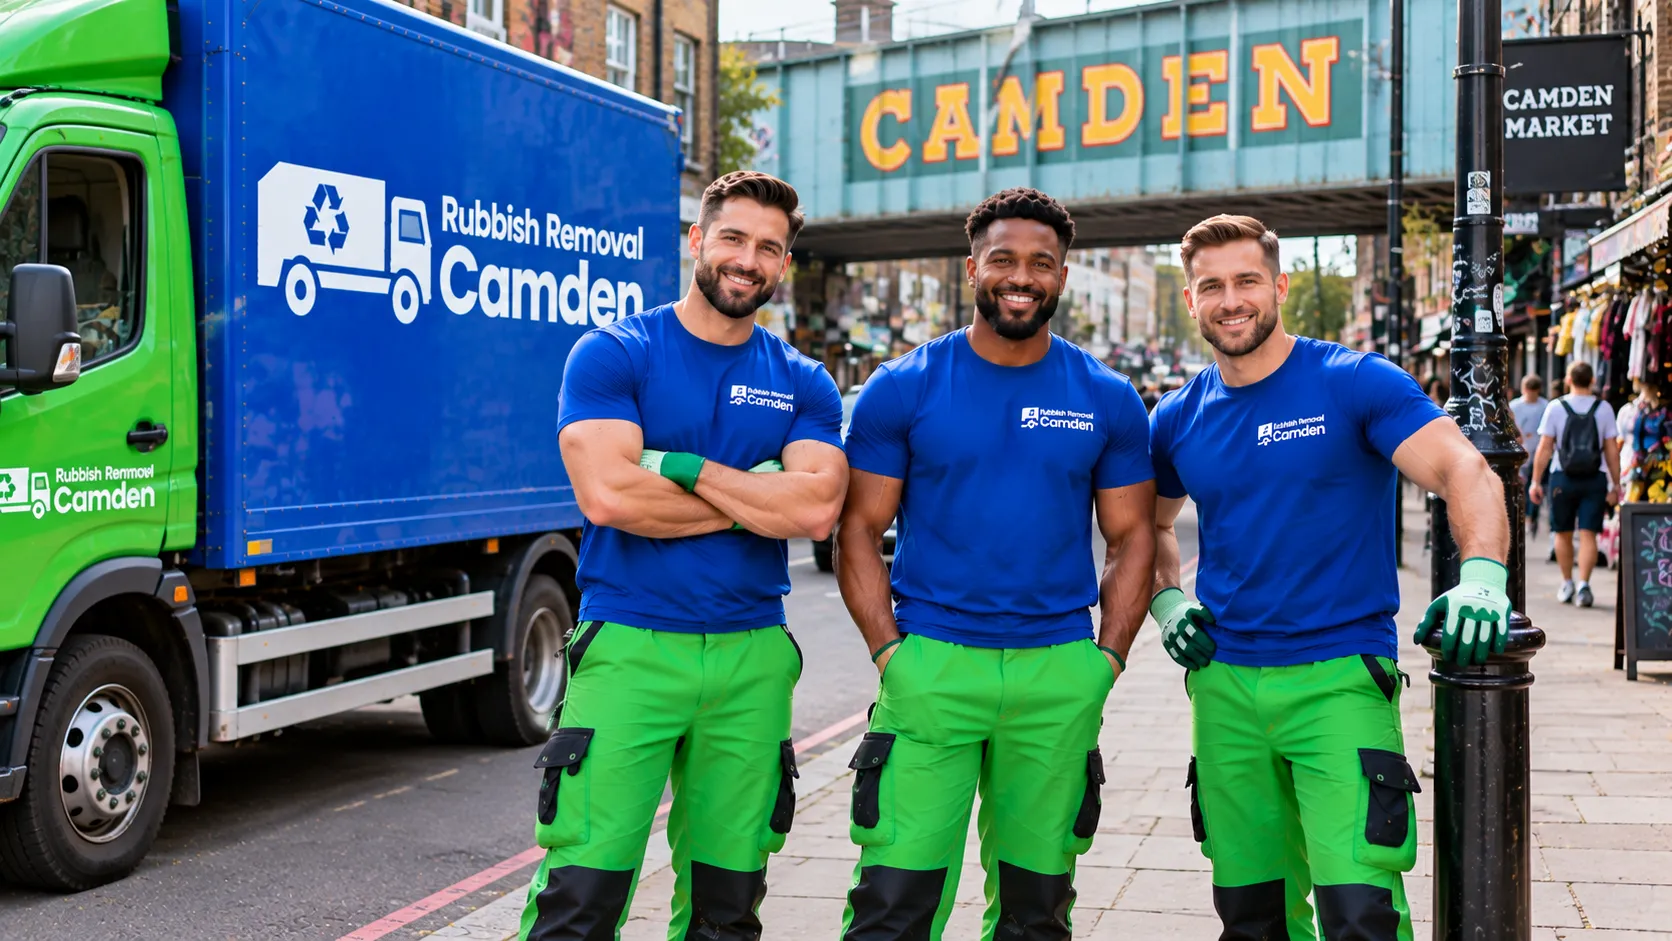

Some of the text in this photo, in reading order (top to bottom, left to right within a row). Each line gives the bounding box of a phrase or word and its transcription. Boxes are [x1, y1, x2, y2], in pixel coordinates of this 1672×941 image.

[860, 36, 1340, 172] CAMDEN
[1502, 84, 1614, 111] CAMDEN
[1505, 113, 1613, 139] MARKET
[441, 195, 644, 260] Rubbish Removal
[439, 244, 644, 328] Camden
[747, 394, 793, 412] Camden
[1040, 416, 1094, 431] Camden
[1272, 424, 1326, 442] Camden
[55, 466, 102, 483] Rubbish
[54, 481, 155, 514] Camden
